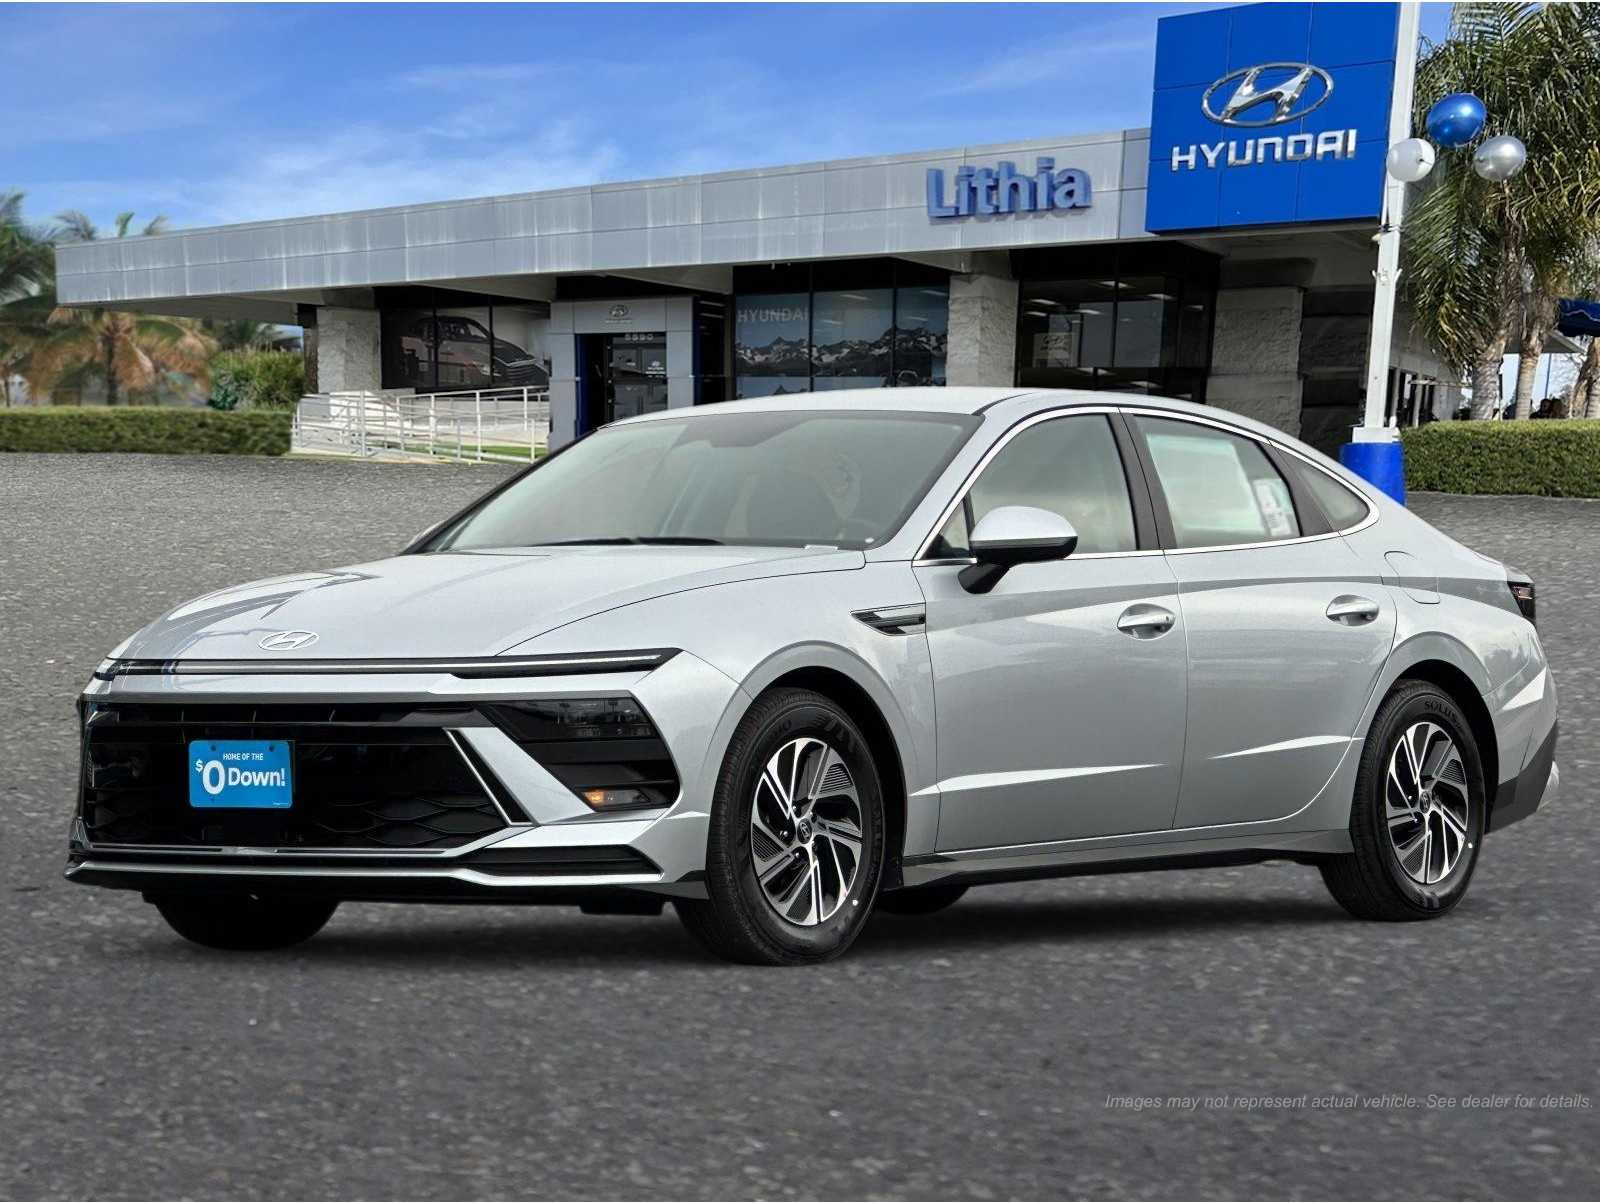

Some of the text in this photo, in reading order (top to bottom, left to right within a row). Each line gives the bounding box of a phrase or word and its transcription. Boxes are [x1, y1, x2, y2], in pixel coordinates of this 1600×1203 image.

[1171, 128, 1357, 172] HYUNDAI
[926, 156, 1093, 218] Lithia
[737, 307, 809, 323] HYUNDAI
[223, 752, 264, 761] HOME OF THE
[227, 767, 286, 787] Down!
